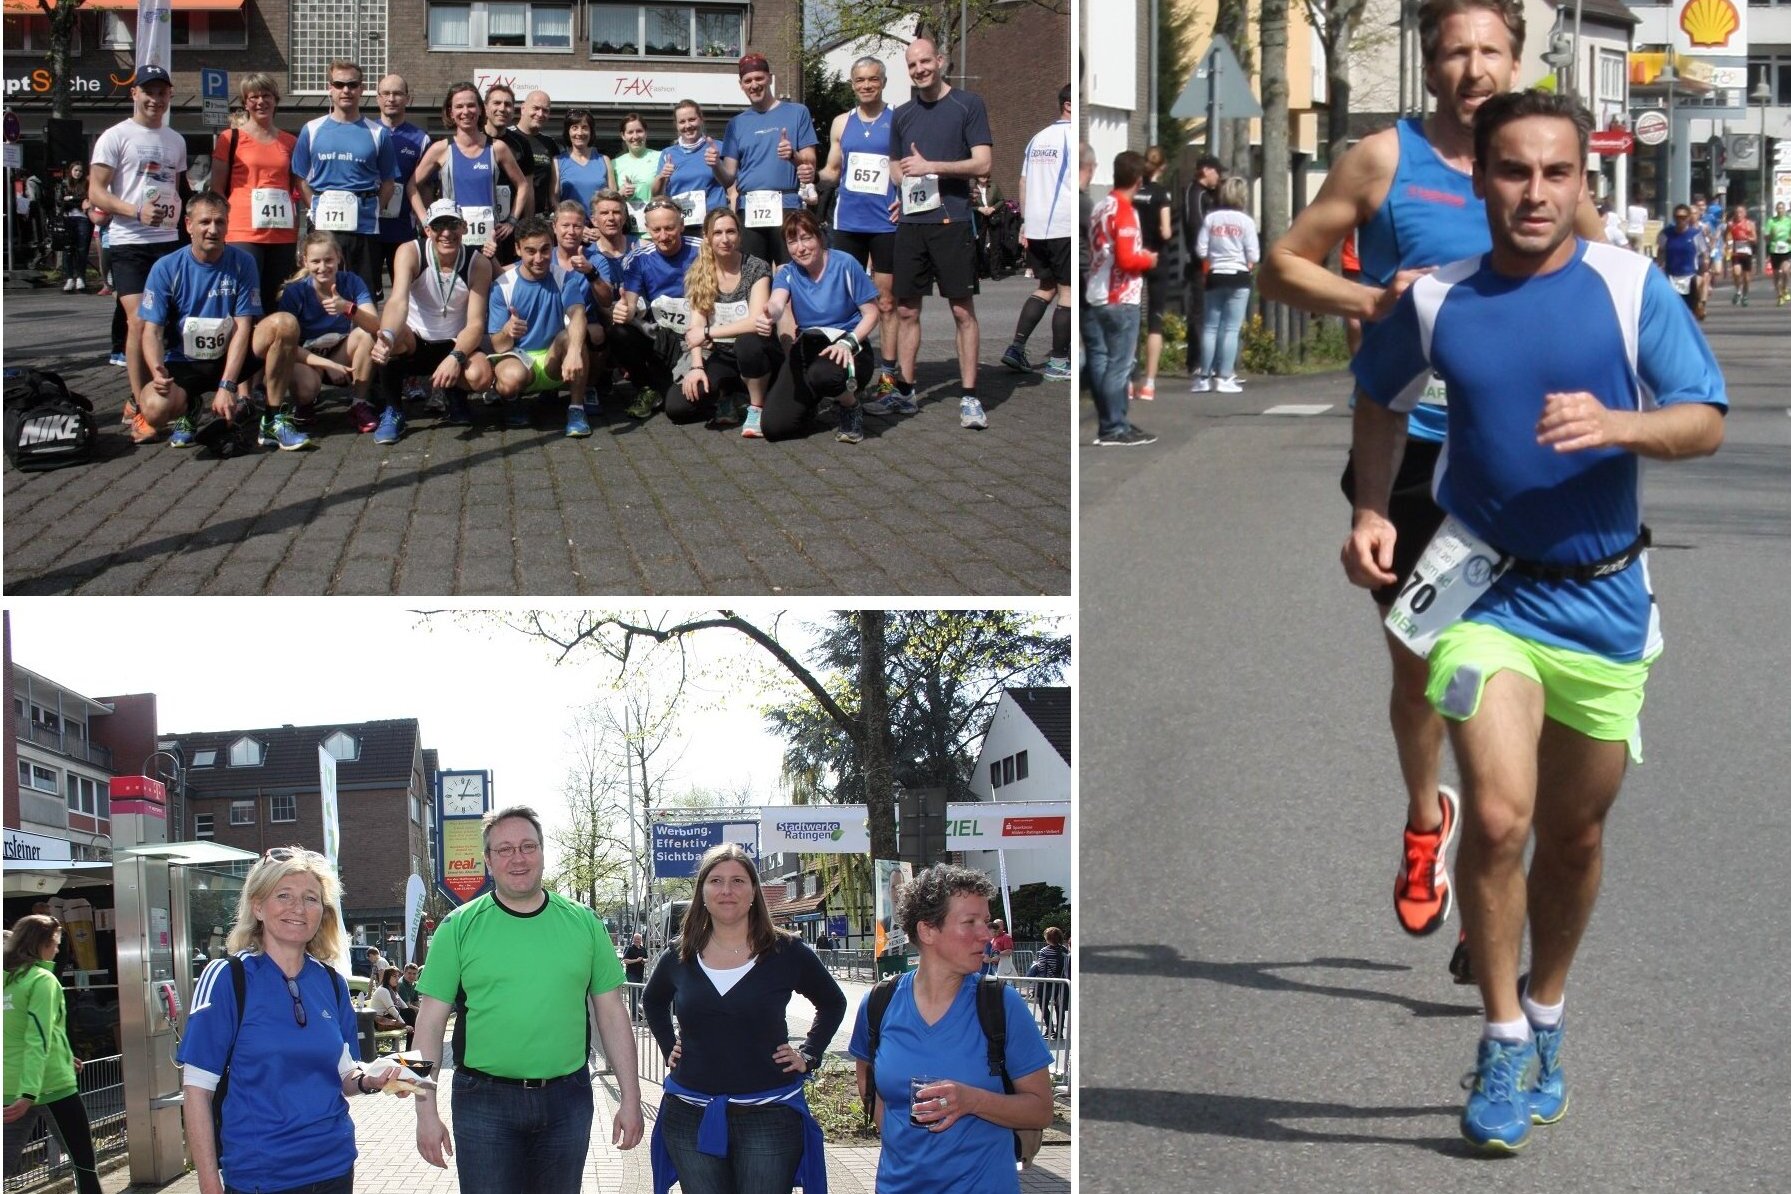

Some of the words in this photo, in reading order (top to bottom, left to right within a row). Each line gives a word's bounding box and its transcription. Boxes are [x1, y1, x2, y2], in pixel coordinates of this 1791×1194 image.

[208, 72, 223, 95] P
[614, 77, 653, 98] TAX
[854, 168, 881, 183] 657
[908, 190, 927, 204] 173
[261, 204, 285, 218] 411
[325, 211, 345, 222] 171
[753, 209, 772, 219] 172
[659, 309, 686, 325] 372
[195, 333, 225, 350] 636
[18, 414, 81, 447] NIKE
[656, 825, 713, 837] Werbung.
[778, 822, 840, 831] Stadtwerke
[785, 830, 831, 841] Ratingen
[656, 839, 713, 849] Effektiv.
